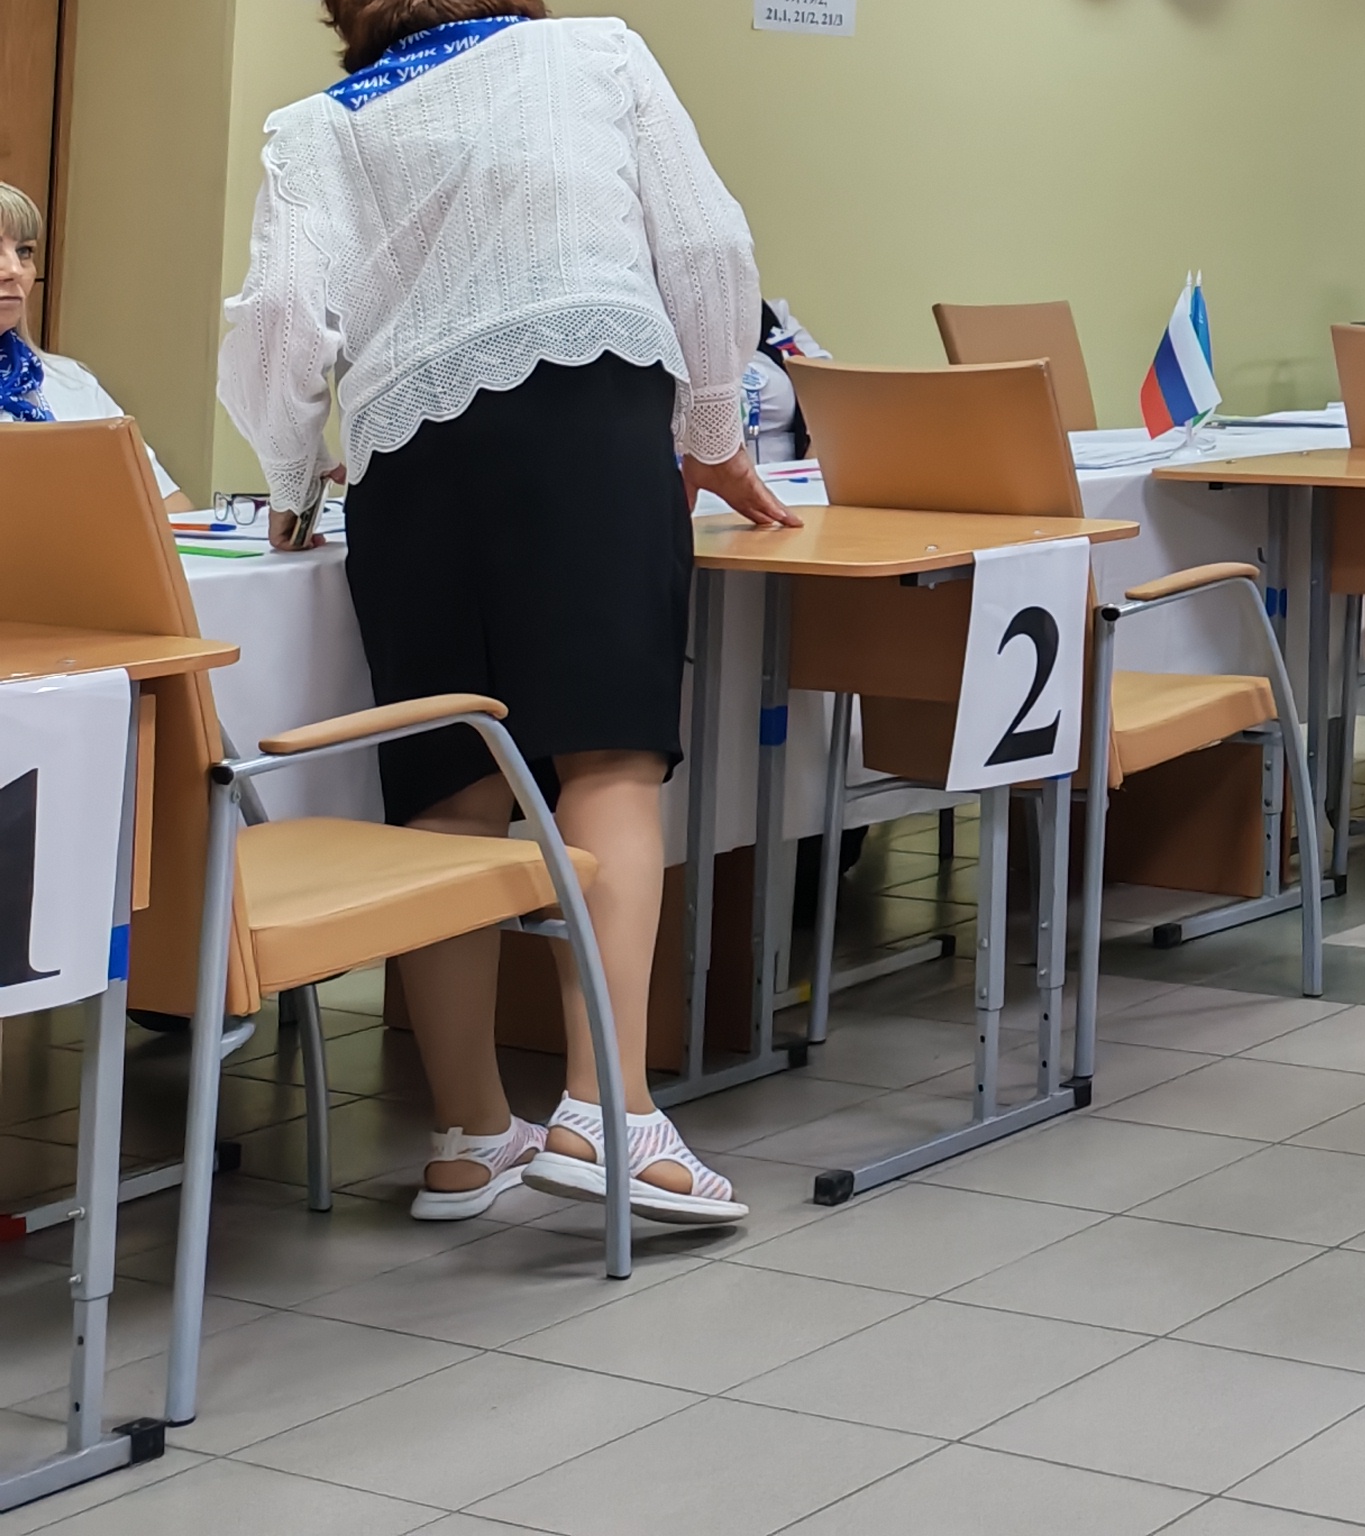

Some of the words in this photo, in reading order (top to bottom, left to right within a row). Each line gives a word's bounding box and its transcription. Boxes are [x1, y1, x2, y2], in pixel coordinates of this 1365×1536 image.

[794, 10, 819, 25] 21/2,
[821, 13, 843, 26] 21/3
[352, 72, 391, 91] УИК
[983, 605, 1061, 767] 2
